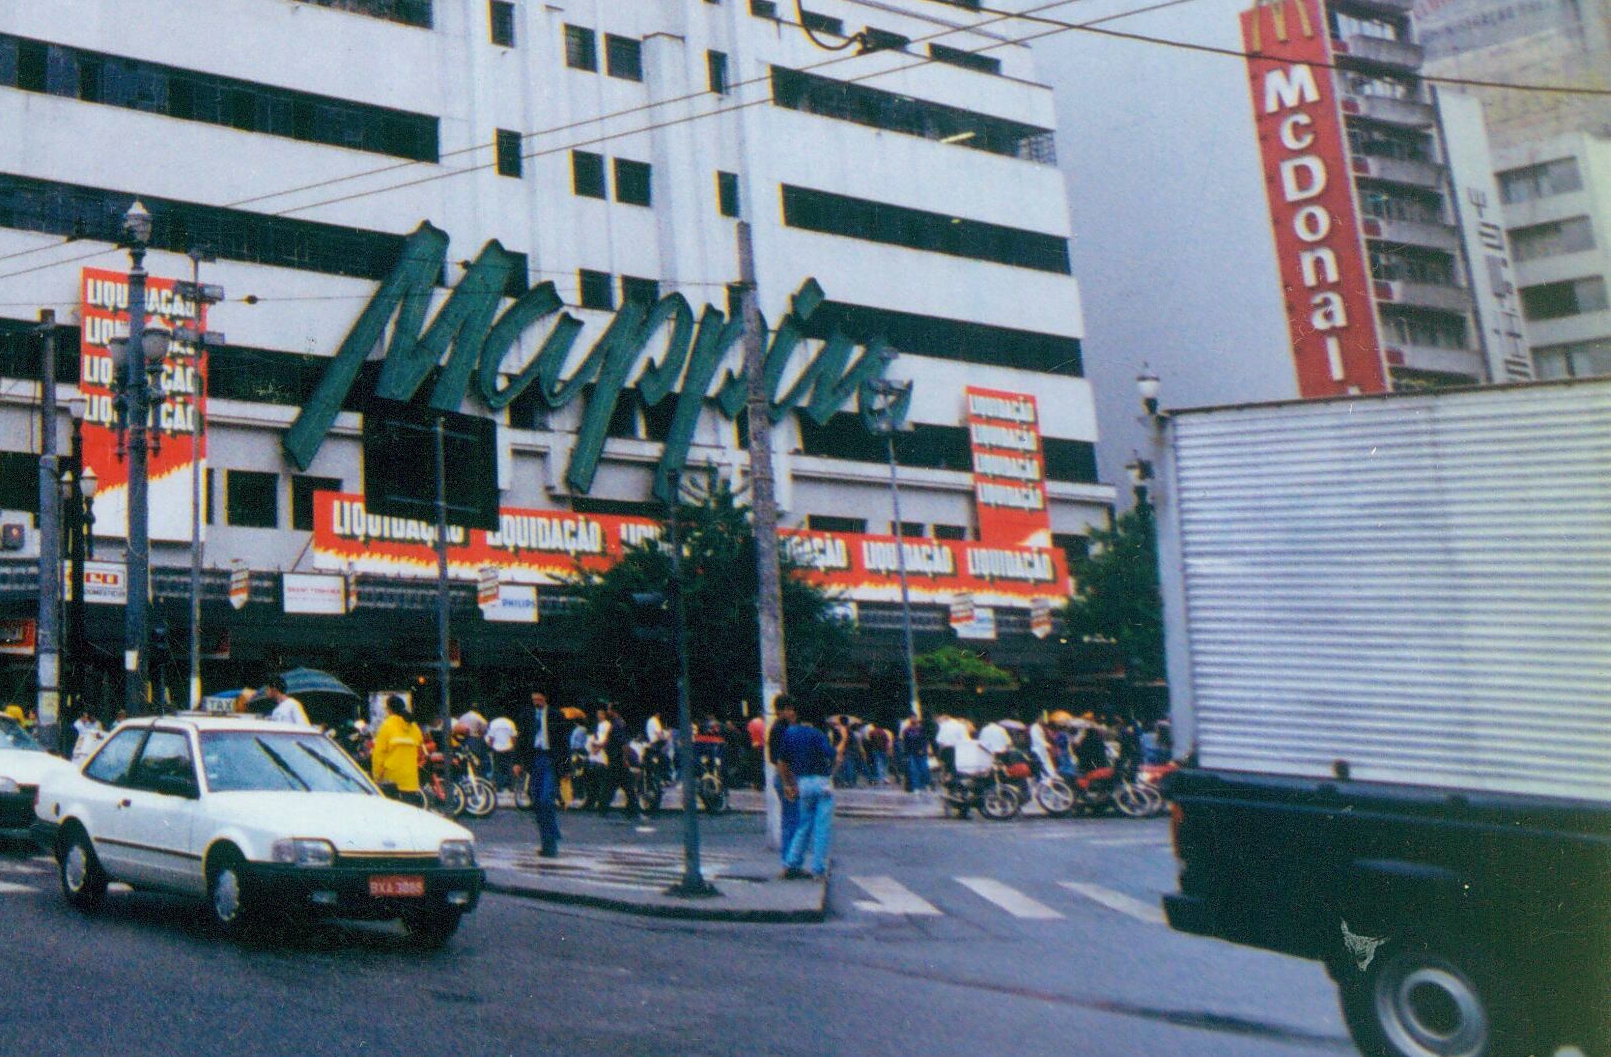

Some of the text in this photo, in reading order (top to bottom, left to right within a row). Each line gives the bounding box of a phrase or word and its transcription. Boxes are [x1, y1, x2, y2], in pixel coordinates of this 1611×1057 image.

[1264, 63, 1363, 395] McDonal
[87, 277, 195, 319] LIQUAÇÃO
[285, 219, 912, 503] Mappin
[333, 499, 465, 548] LIQUIDAÇO
[863, 538, 954, 577] LIQUDAÇÃO
[501, 598, 535, 608] PHILIPS
